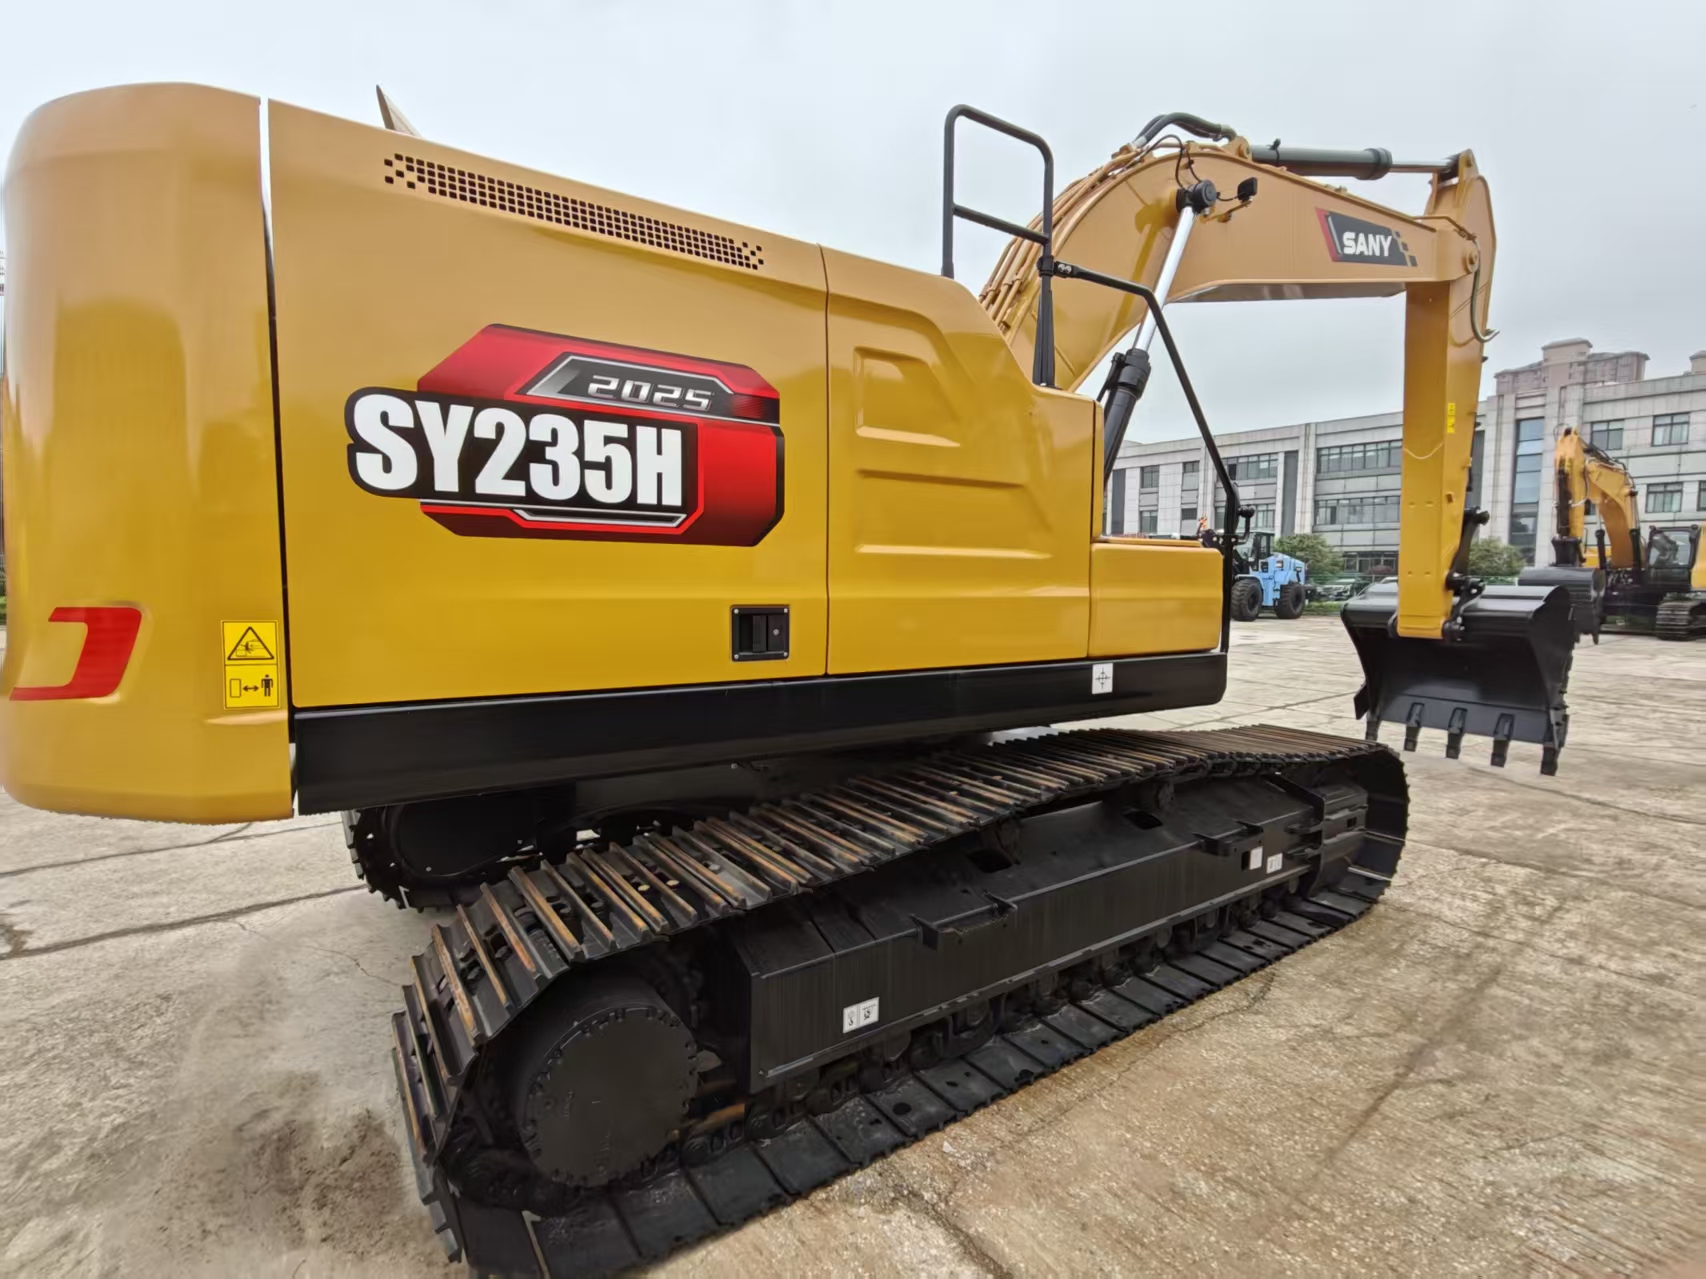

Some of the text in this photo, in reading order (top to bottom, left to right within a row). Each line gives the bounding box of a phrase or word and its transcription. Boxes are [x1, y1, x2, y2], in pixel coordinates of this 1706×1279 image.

[1342, 231, 1393, 257] SANY
[588, 375, 712, 411] 2025
[353, 393, 682, 507] SY235H
